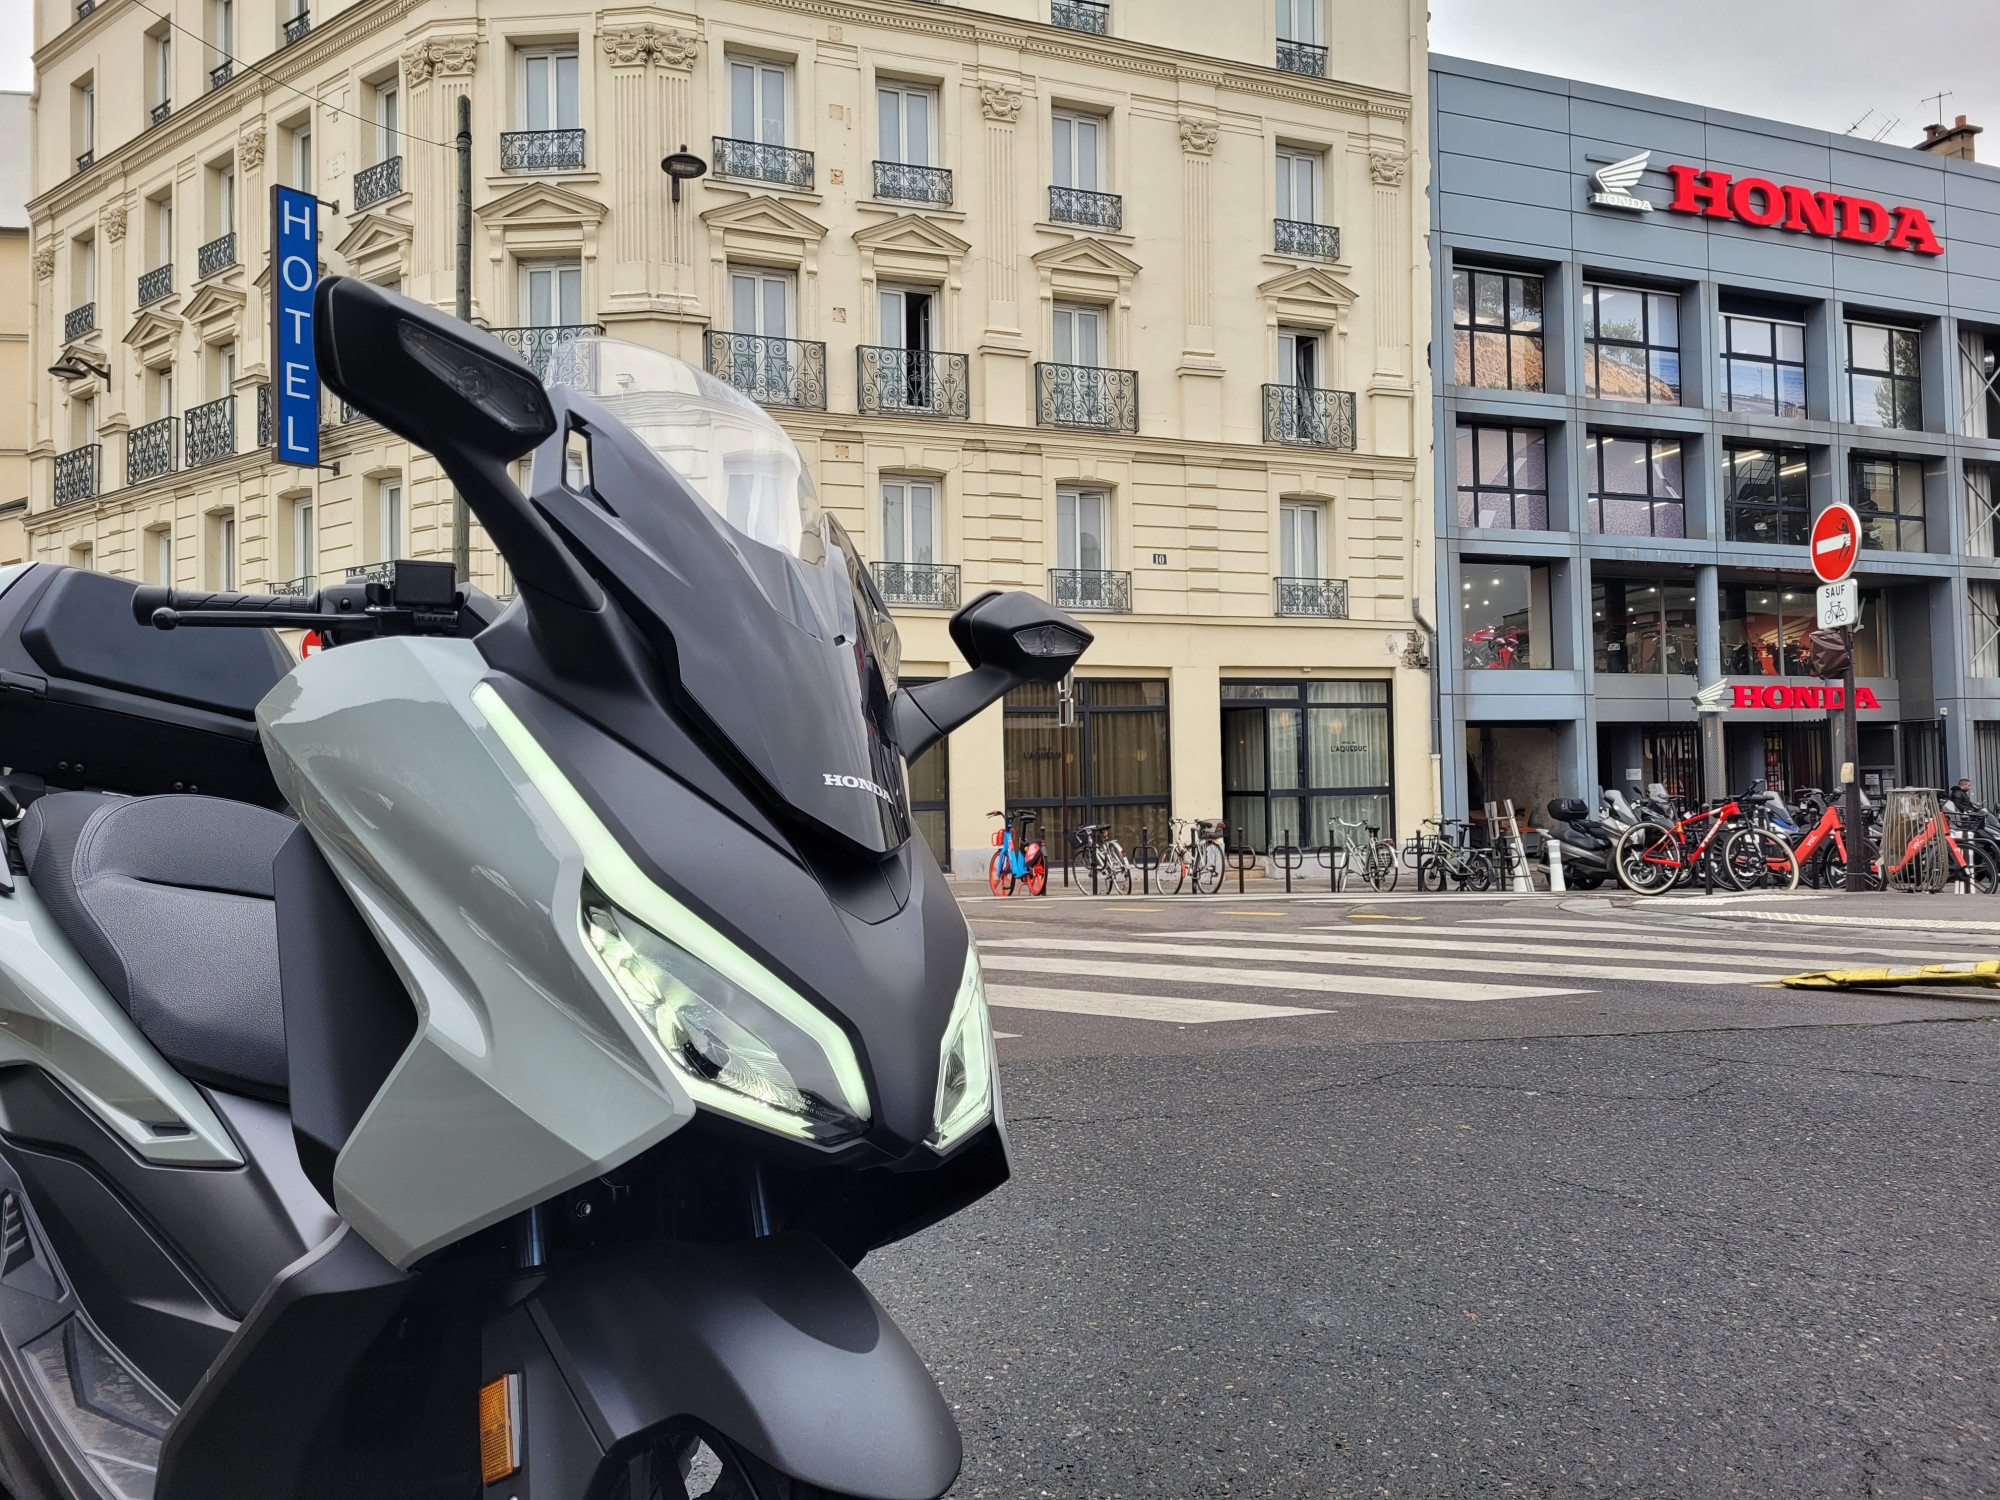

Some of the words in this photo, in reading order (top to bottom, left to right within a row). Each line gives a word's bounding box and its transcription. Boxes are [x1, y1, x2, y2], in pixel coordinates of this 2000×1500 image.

[1595, 193, 1654, 212] HONDA
[1668, 164, 1945, 256] HONDA
[282, 200, 313, 453] HOTEL
[1154, 554, 1166, 565] 10
[1825, 584, 1845, 598] SAUF
[1730, 684, 1882, 710] HONDA
[1023, 751, 1062, 760] L'AQUEDU
[1330, 745, 1368, 753] L'AQUEDUC
[822, 773, 894, 805] HONDA
